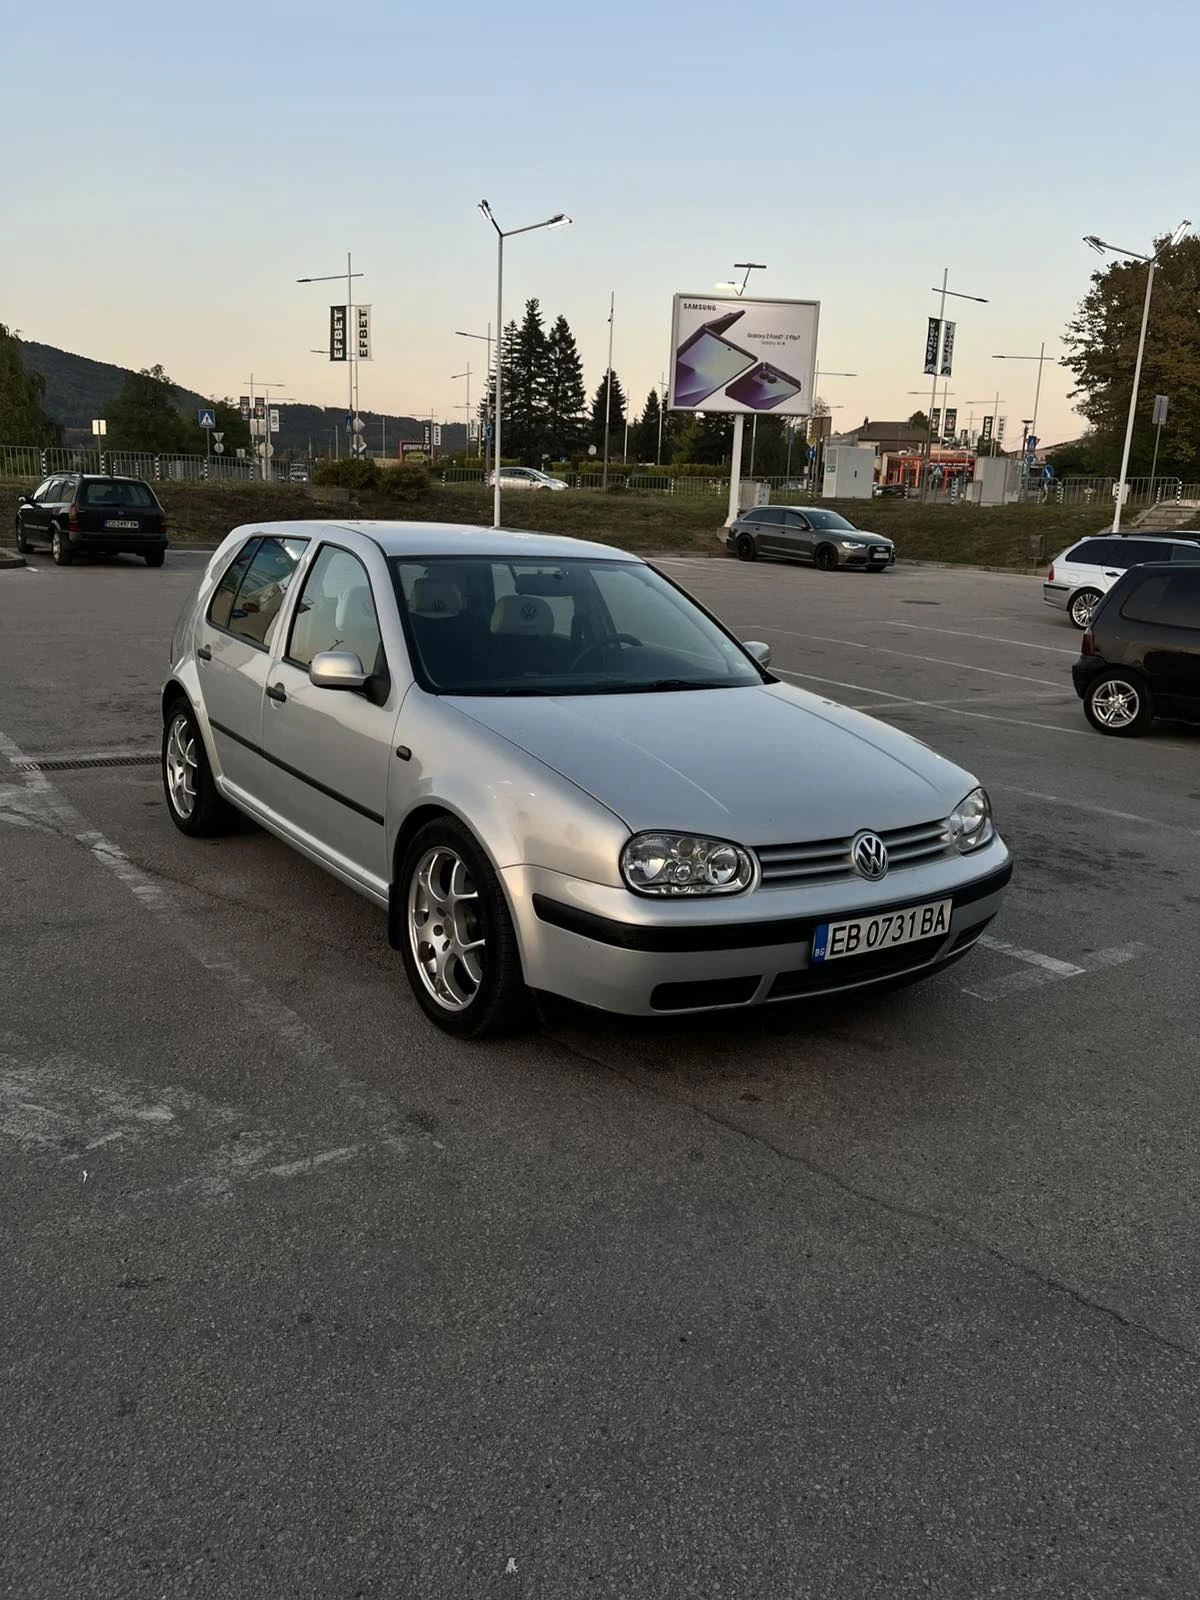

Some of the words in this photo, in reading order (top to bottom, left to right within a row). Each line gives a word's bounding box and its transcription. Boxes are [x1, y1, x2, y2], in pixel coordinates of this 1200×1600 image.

[683, 303, 717, 311] SAMSUNG
[334, 310, 343, 358] EFBET
[358, 309, 368, 357] EFBET
[927, 320, 936, 360] efbet
[943, 324, 952, 362] efbet
[854, 836, 886, 876] VW
[830, 923, 861, 956] EB
[866, 911, 916, 948] 0731
[920, 905, 945, 935] BA
[814, 947, 825, 957] BG
